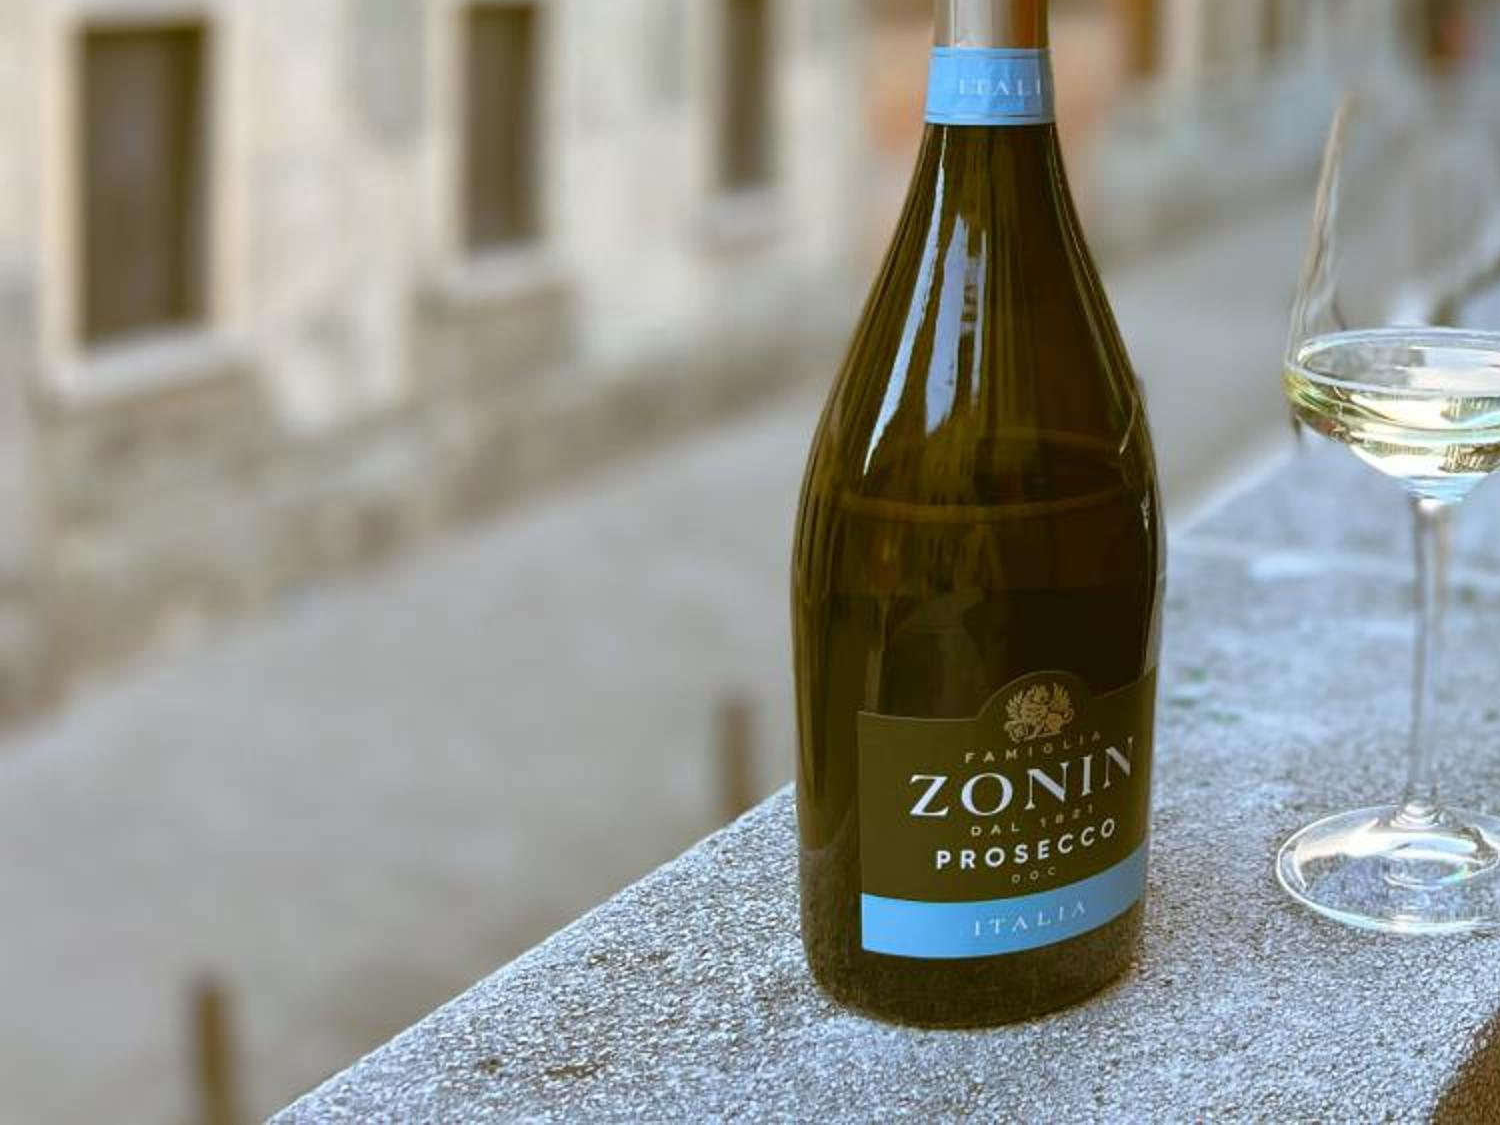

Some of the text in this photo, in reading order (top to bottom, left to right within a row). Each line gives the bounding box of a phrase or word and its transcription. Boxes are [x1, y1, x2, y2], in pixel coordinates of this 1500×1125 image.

[959, 77, 1042, 96] ITALI
[909, 736, 1134, 817] ZONIN
[935, 818, 1115, 870] PROSECCO
[971, 821, 1021, 837] DAL
[974, 899, 1087, 937] ITALIA
